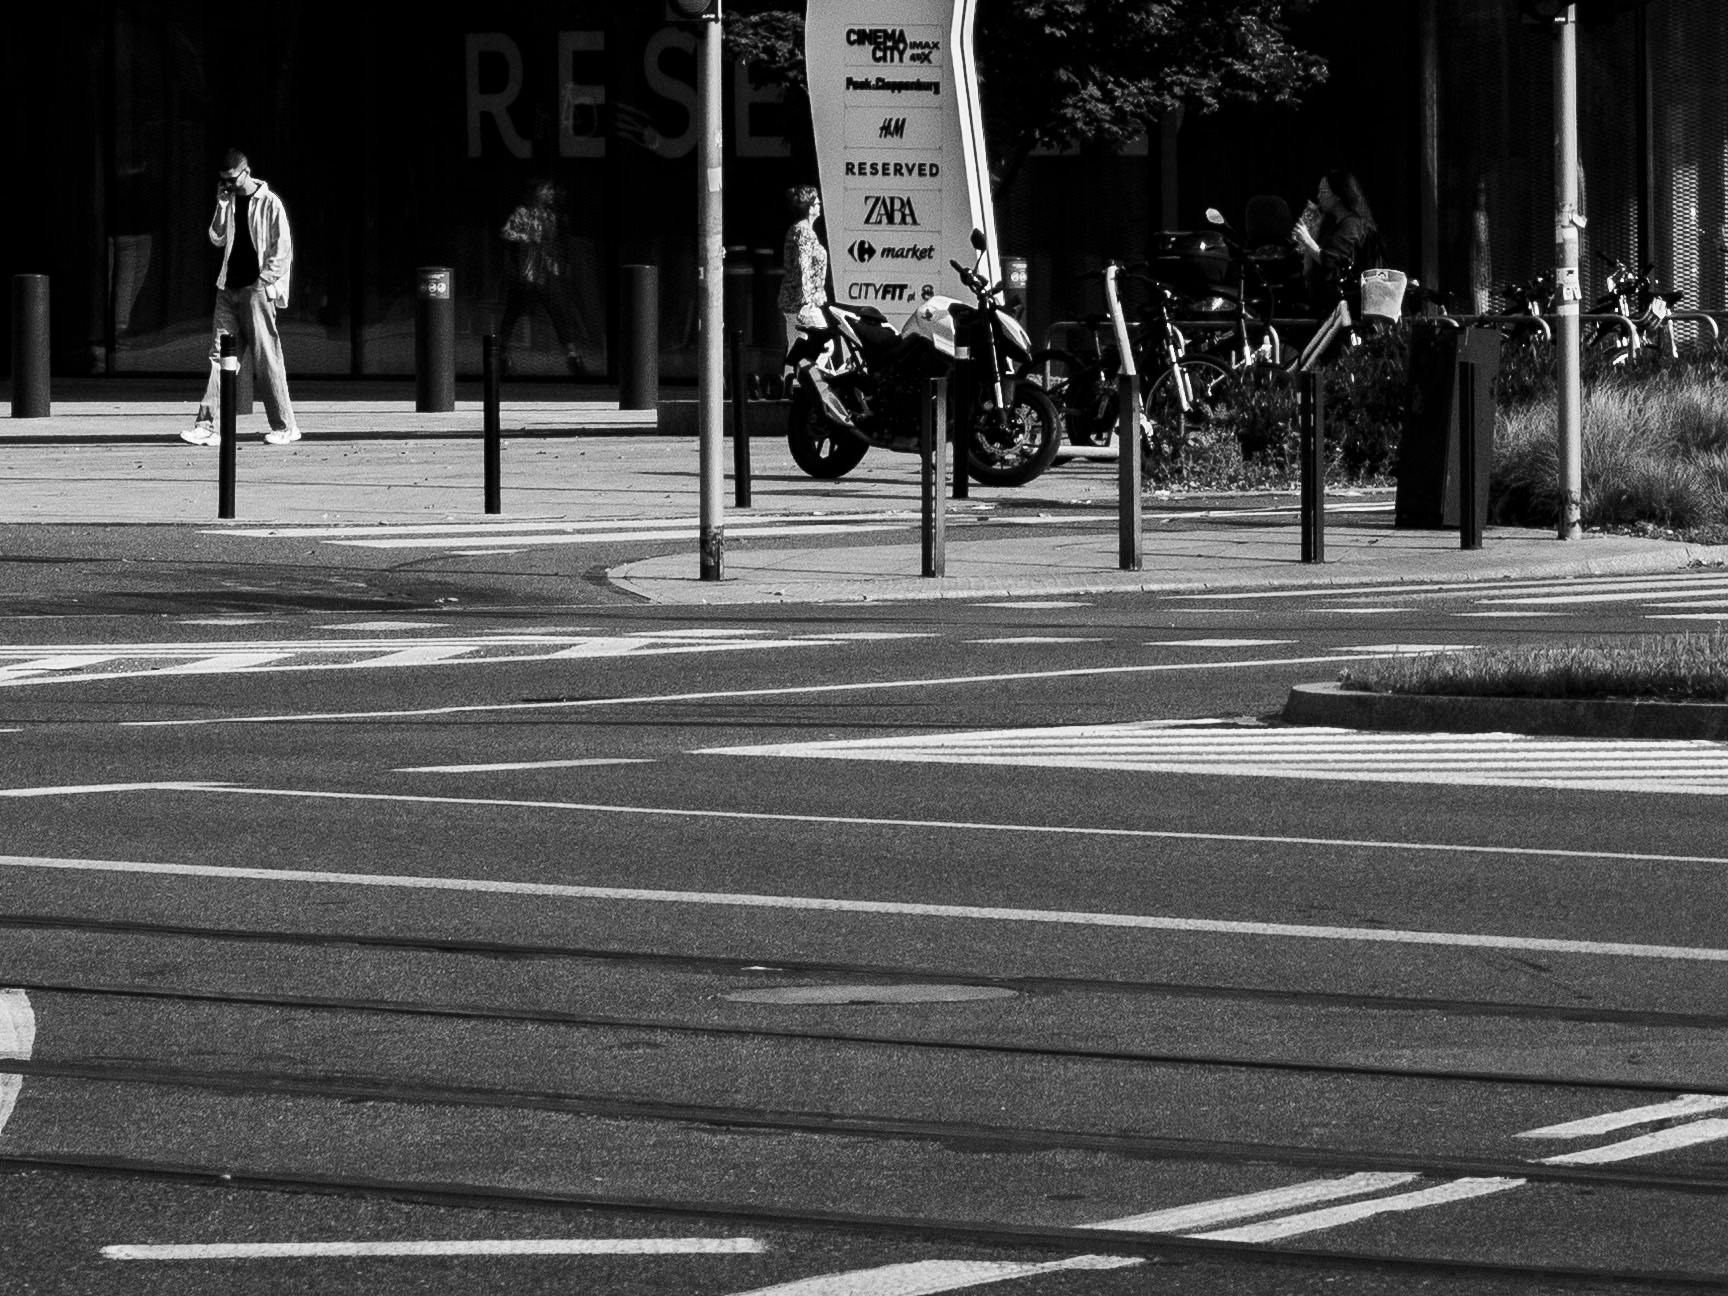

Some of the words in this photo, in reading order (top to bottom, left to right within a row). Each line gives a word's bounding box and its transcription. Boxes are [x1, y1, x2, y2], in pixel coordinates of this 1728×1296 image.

[846, 28, 908, 46] CINEMA
[872, 46, 907, 63] CITY
[845, 161, 940, 177] RESERVED
[863, 195, 921, 226] ZARA
[880, 244, 935, 261] market
